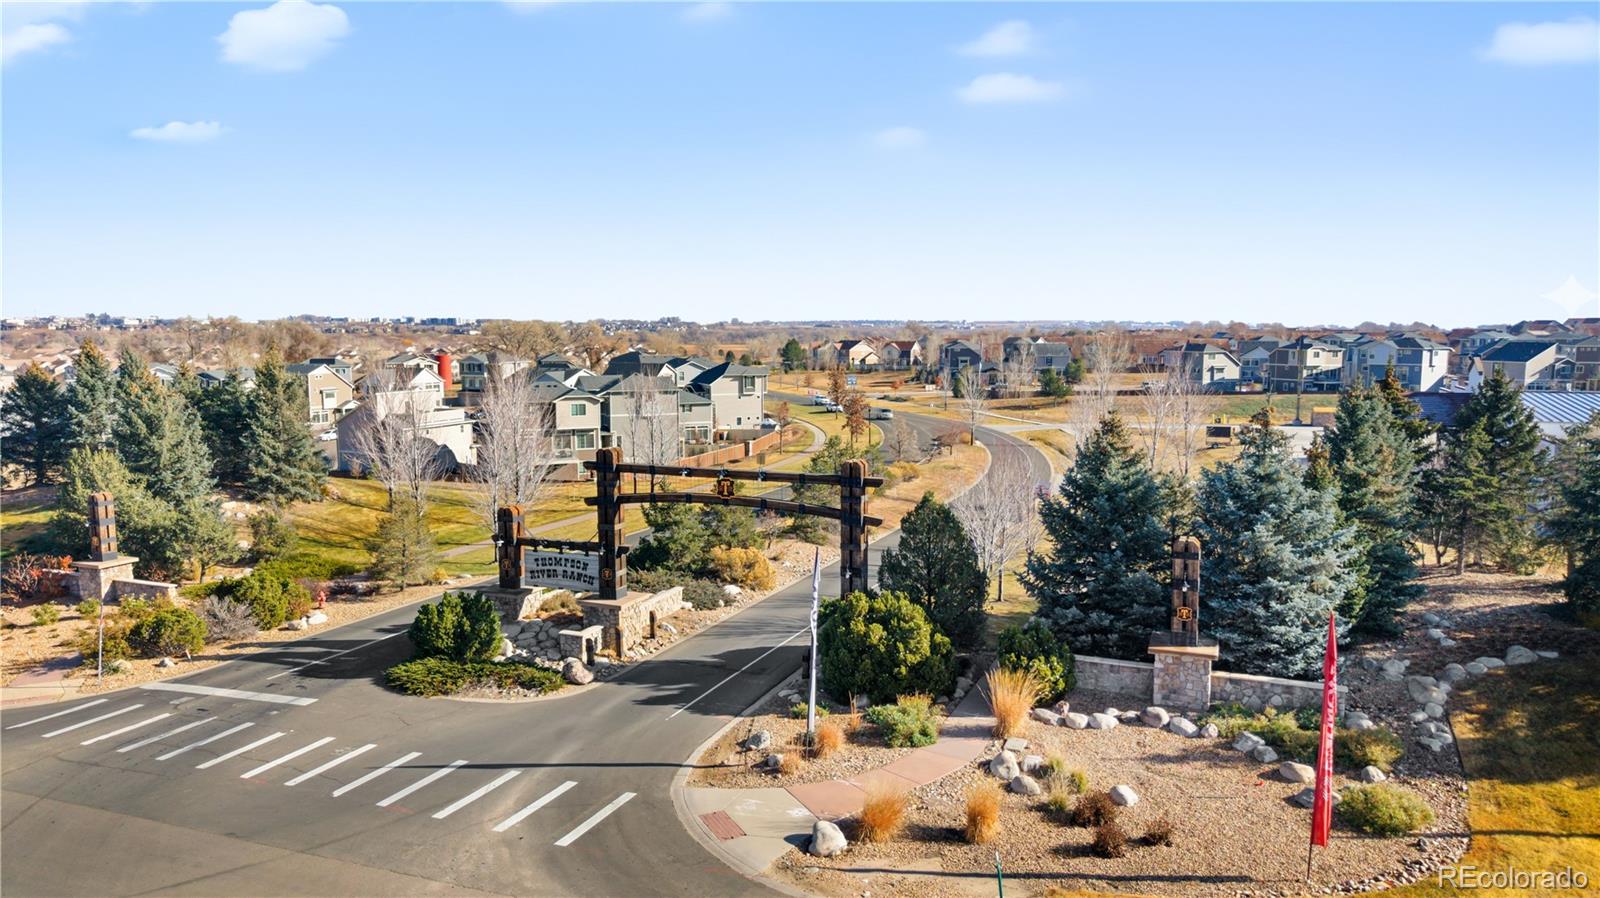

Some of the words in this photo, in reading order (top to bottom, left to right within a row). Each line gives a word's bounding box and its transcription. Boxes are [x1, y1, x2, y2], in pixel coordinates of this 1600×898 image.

[720, 480, 731, 496] T
[534, 556, 589, 572] THOMPSON
[529, 569, 559, 580] RIVER
[562, 570, 595, 586] RANCH
